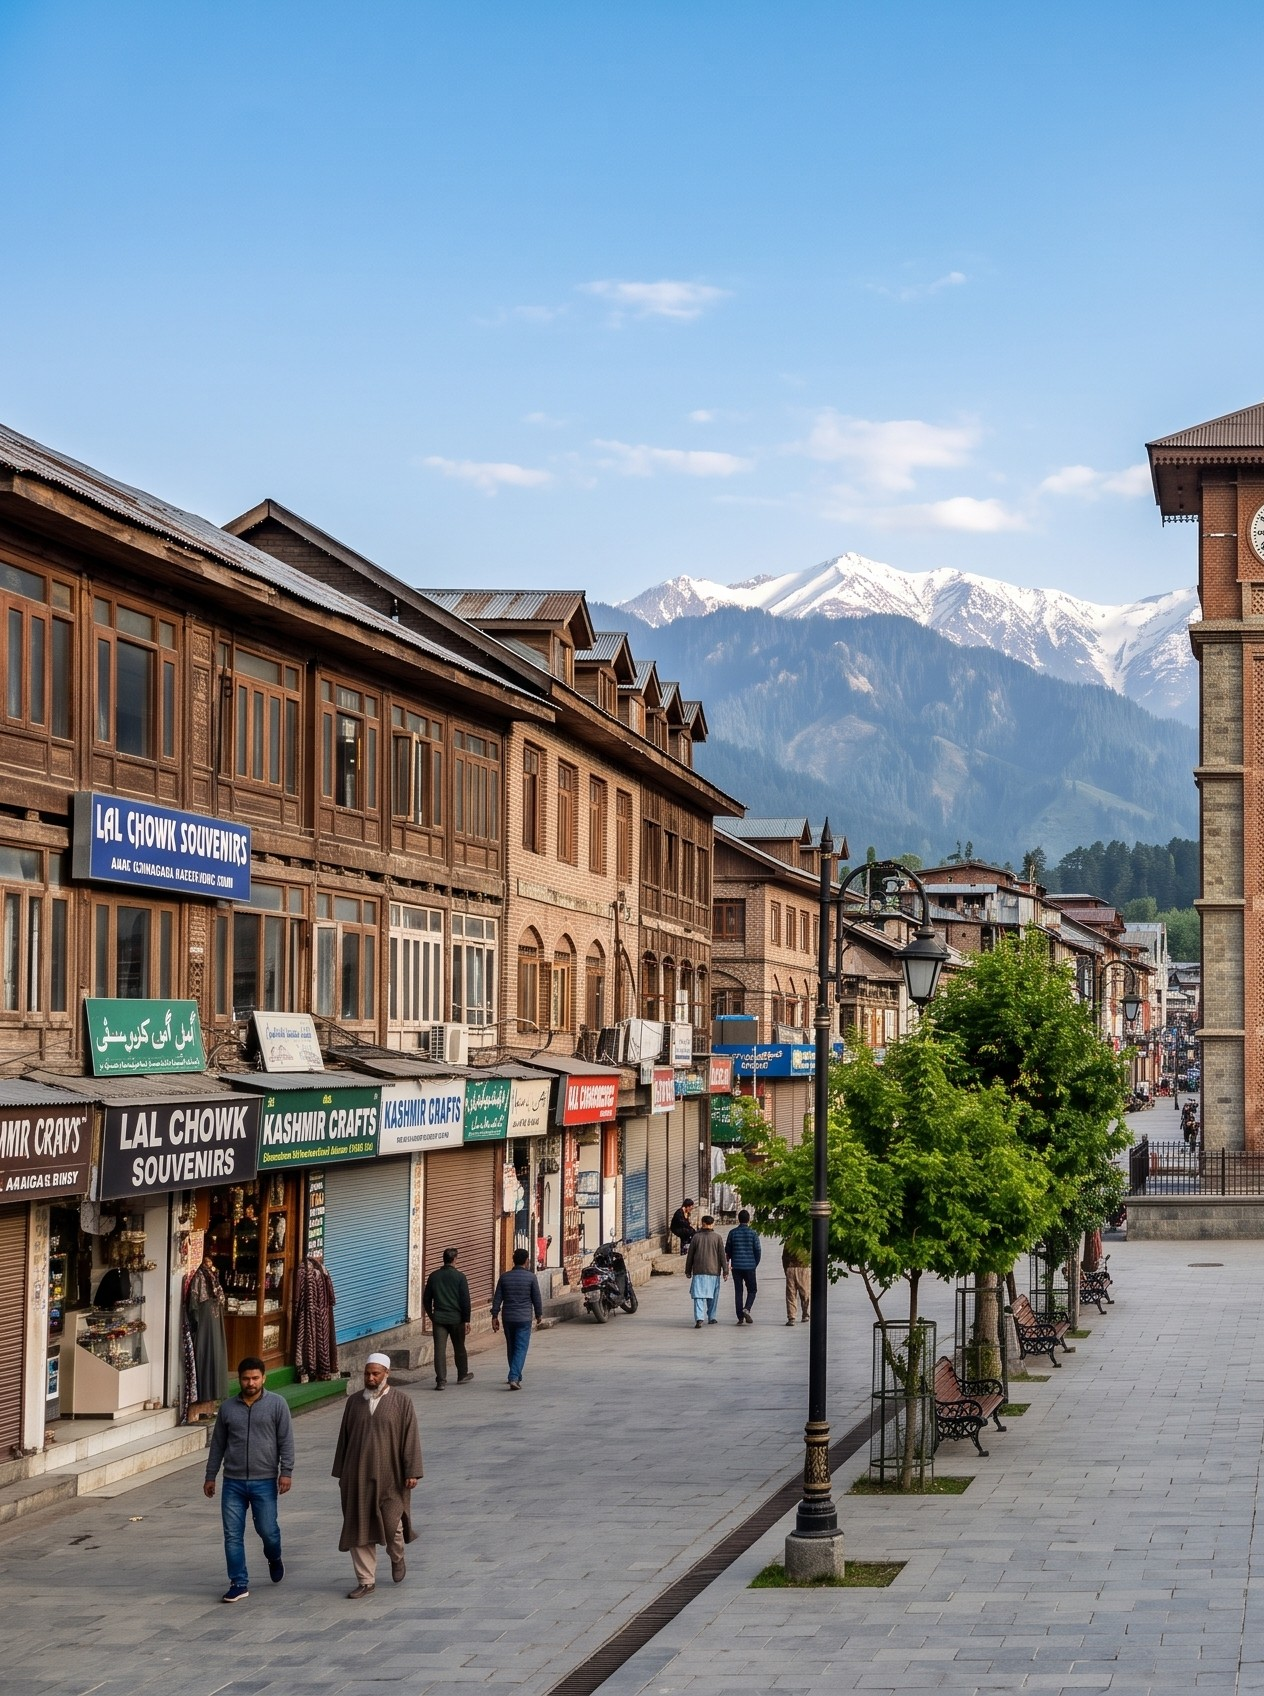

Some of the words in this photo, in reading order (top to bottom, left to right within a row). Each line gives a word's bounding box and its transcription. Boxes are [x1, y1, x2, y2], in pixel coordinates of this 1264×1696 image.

[96, 803, 123, 844] LAL
[127, 811, 177, 852] CHOWK
[180, 822, 248, 867] SOUVENIRS
[119, 1111, 163, 1151] LAL
[168, 1105, 249, 1146] CHOWK
[262, 1110, 327, 1146] KASHMIR
[328, 1107, 378, 1140] CRAFTS
[384, 1098, 427, 1130] KASHMIR
[428, 1096, 461, 1126] CRAFTS
[131, 1147, 235, 1187] SOUVENIRS
